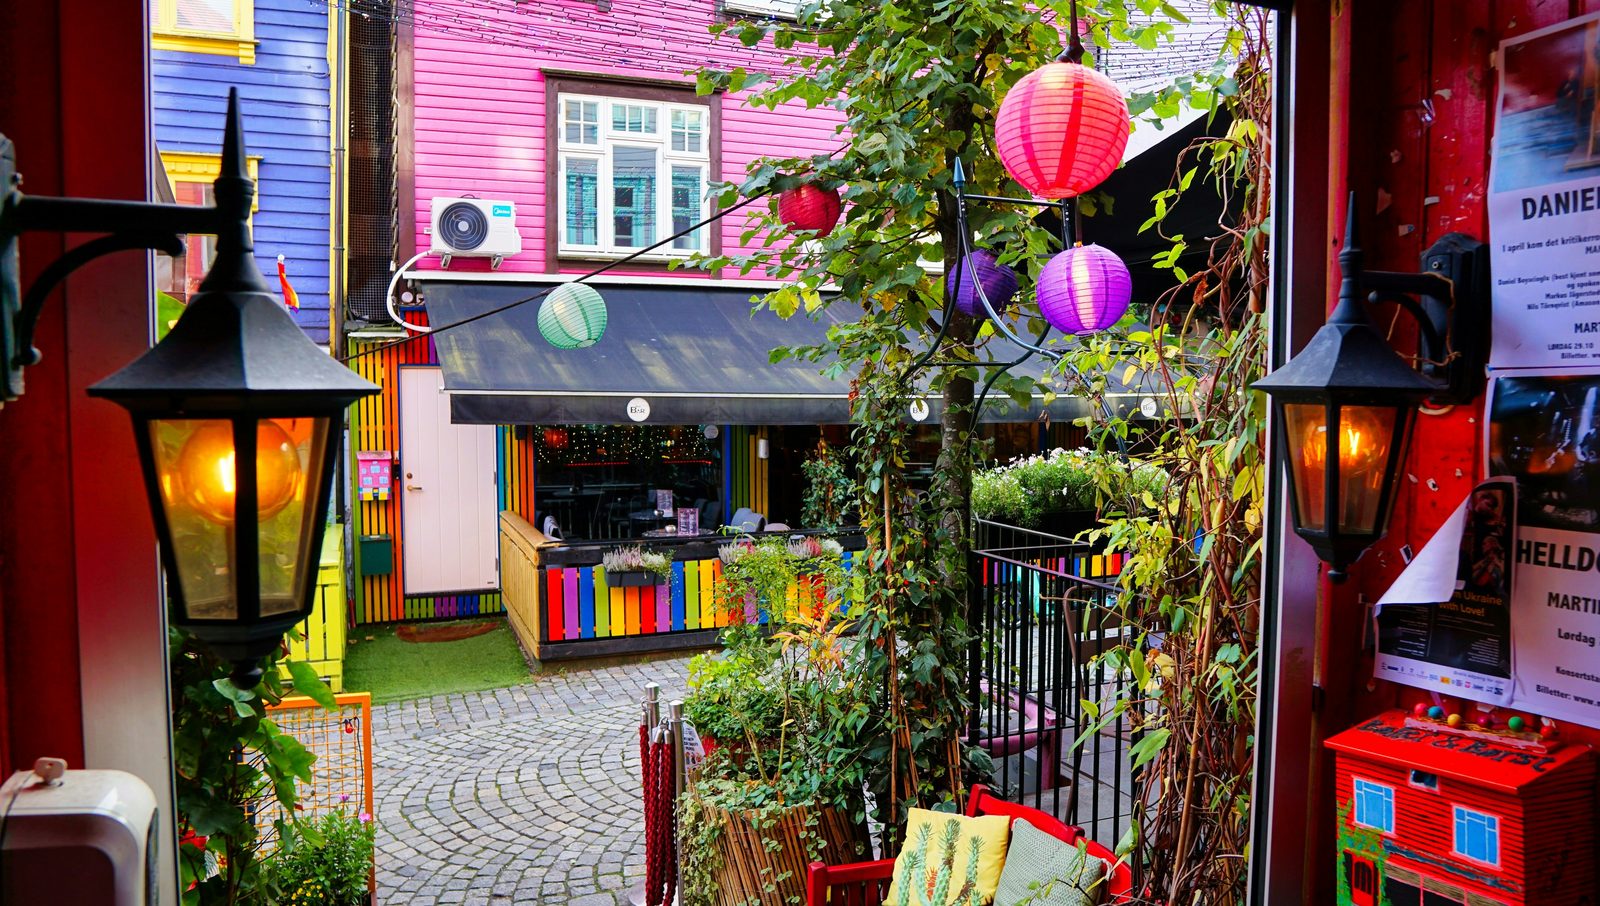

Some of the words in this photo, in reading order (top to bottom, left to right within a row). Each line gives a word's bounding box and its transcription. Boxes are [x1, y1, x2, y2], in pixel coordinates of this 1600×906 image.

[1521, 186, 1600, 220] DANIE
[1507, 243, 1525, 253] april
[1527, 241, 1543, 250] kom
[1545, 239, 1559, 248] det
[1585, 245, 1600, 255] MA
[1516, 539, 1600, 574] HELLD
[1463, 590, 1504, 606] Ukraine
[1547, 592, 1600, 615] MARTI
[1460, 603, 1486, 617] Love!
[1558, 627, 1596, 648] Lørdag
[1431, 734, 1460, 750] &
